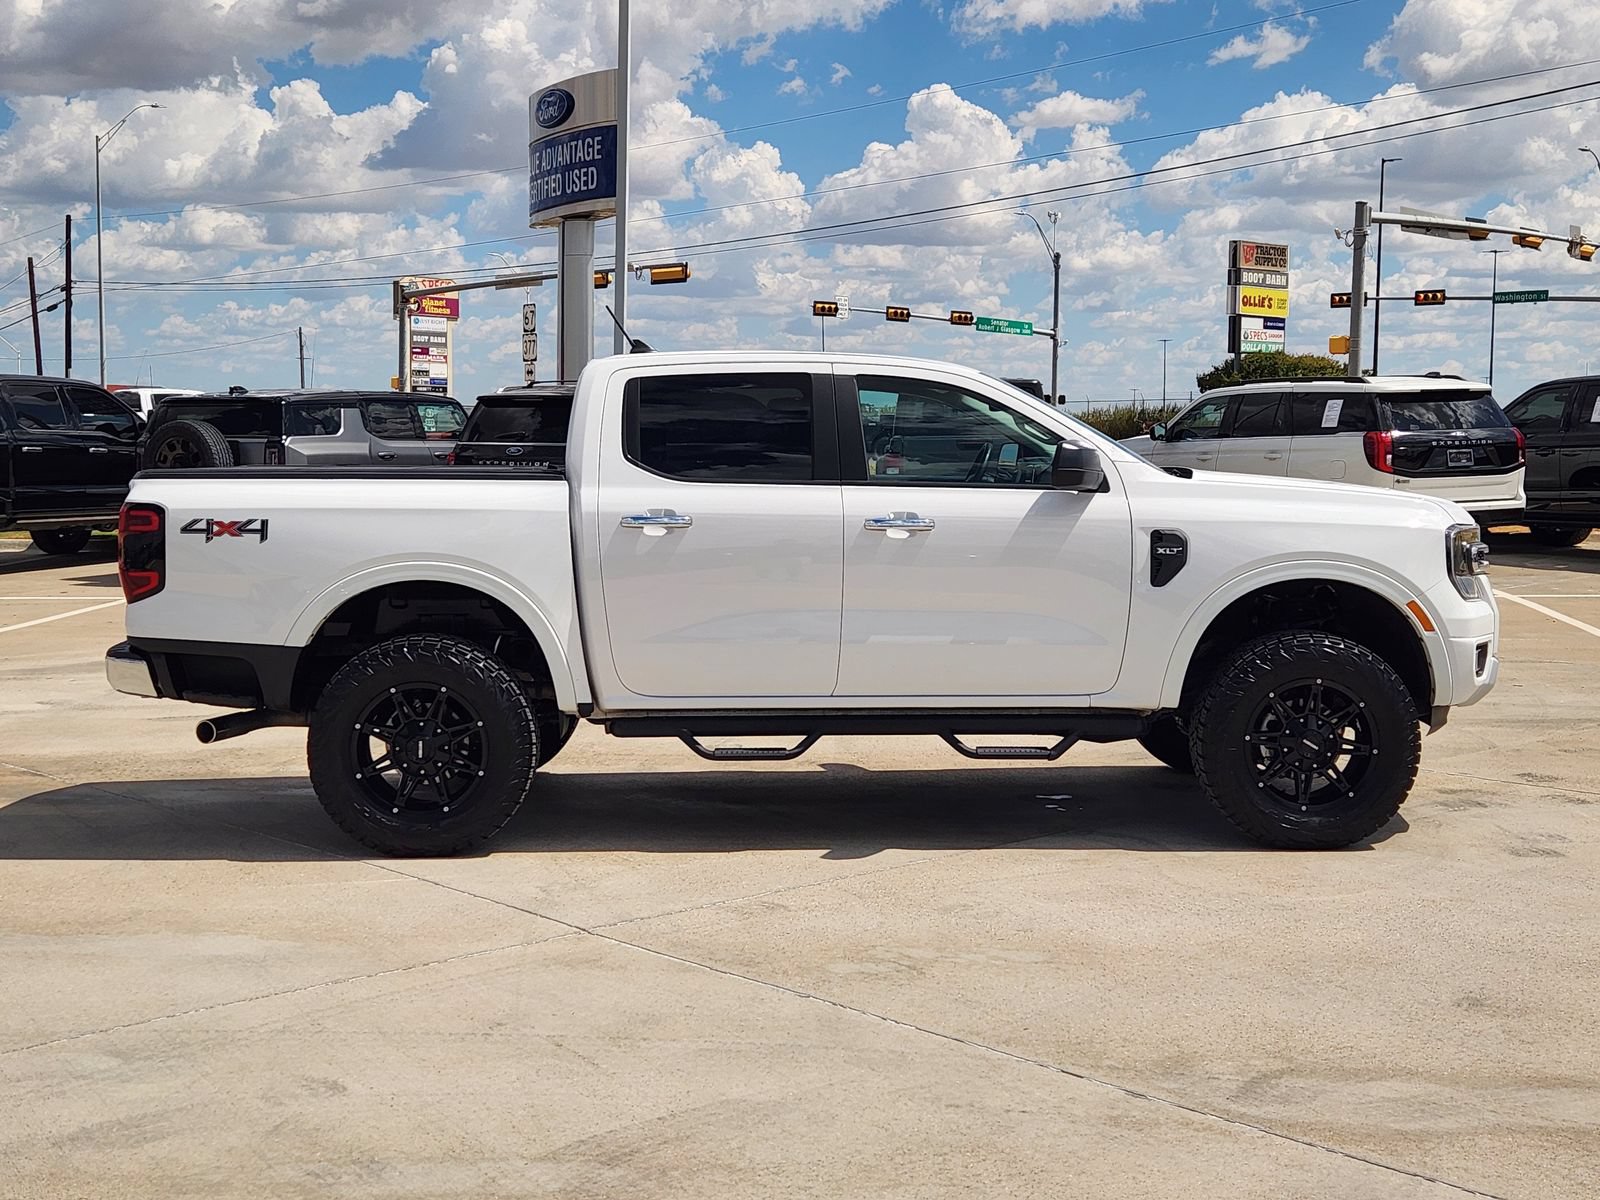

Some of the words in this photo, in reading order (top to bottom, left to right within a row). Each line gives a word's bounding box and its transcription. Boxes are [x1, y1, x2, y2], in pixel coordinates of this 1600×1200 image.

[541, 136, 602, 172] ADVANTAGE
[565, 166, 597, 195] USED
[1255, 245, 1287, 257] TRACTOR
[1255, 256, 1278, 267] SUPPLY
[1242, 271, 1264, 284] BOOT
[1265, 273, 1287, 286] BARN
[422, 298, 447, 307] planet
[1494, 293, 1538, 302] Washington
[425, 305, 451, 315] fitness
[524, 310, 535, 326] 67
[991, 319, 1009, 327] Senator
[978, 323, 995, 331] Robert
[1000, 326, 1021, 335] Glasgow
[523, 339, 536, 356] 377
[1156, 547, 1183, 555] XLT
